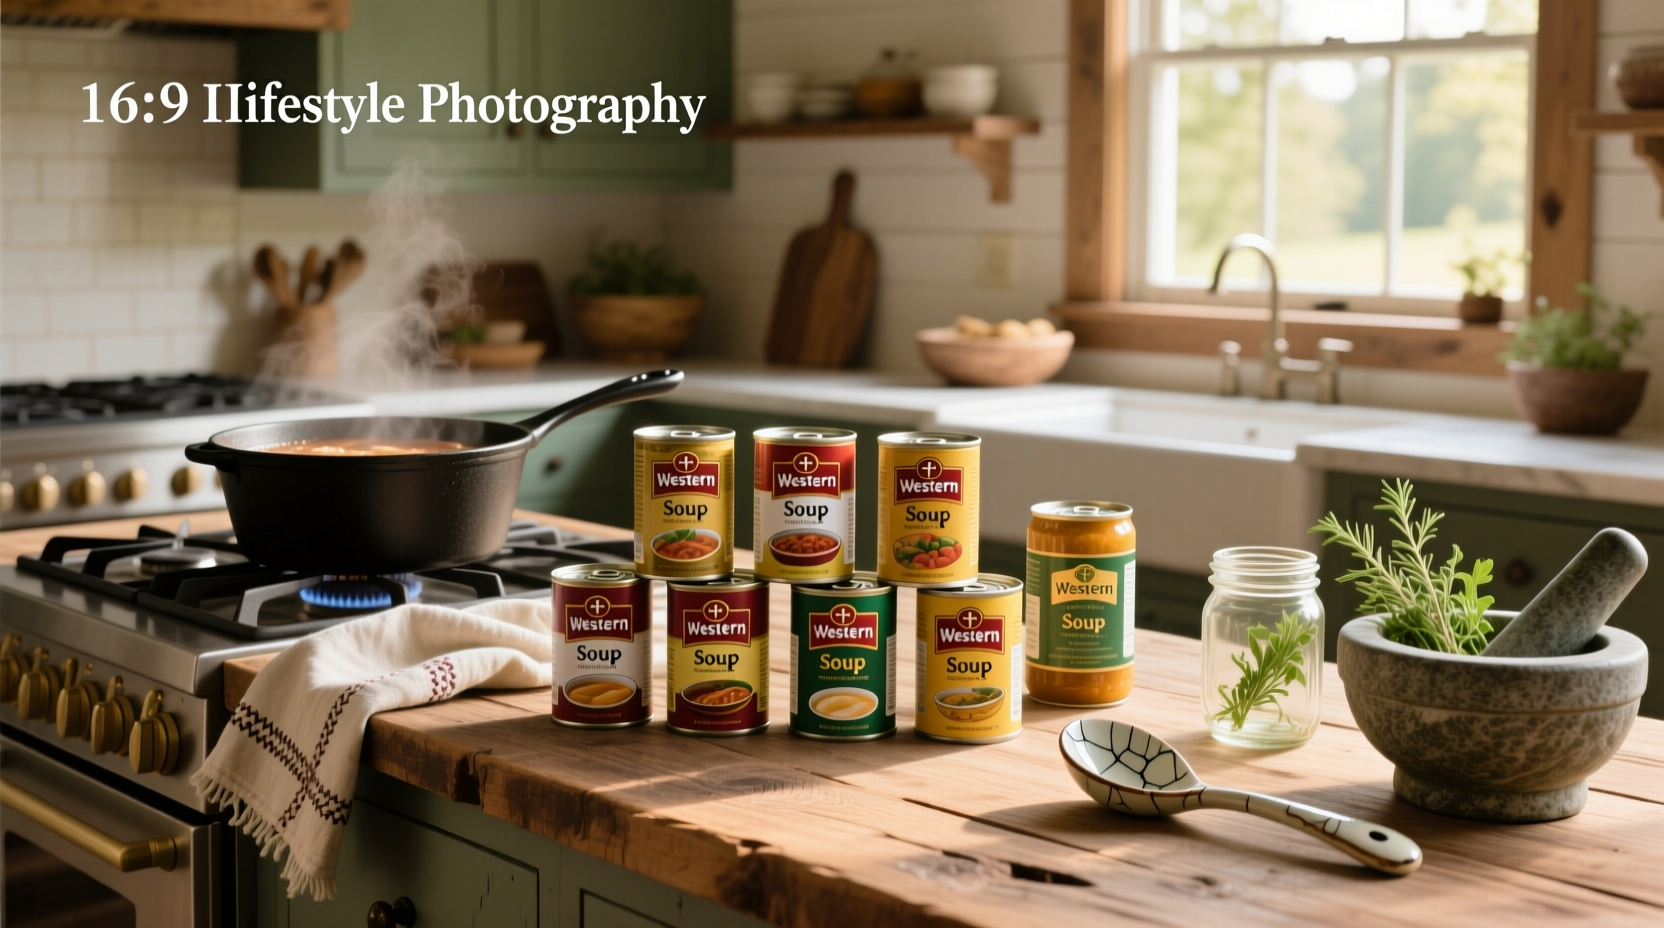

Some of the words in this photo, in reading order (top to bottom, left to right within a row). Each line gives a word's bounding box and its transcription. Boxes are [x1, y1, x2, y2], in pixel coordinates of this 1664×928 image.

[657, 473, 715, 487] Western
[777, 473, 836, 488] Western
[900, 479, 959, 494] Western
[663, 500, 708, 521] Soup
[784, 501, 829, 521] Soup
[905, 506, 950, 528] Soup
[1055, 581, 1113, 595] Western
[570, 616, 629, 631] Western
[687, 621, 746, 636] Western
[813, 624, 873, 639] Western
[1062, 613, 1106, 633] Soup
[940, 627, 1000, 643] Western
[577, 645, 622, 665] Soup
[693, 650, 739, 671] Soup
[819, 653, 866, 675] Soup
[946, 657, 992, 679] Soup
